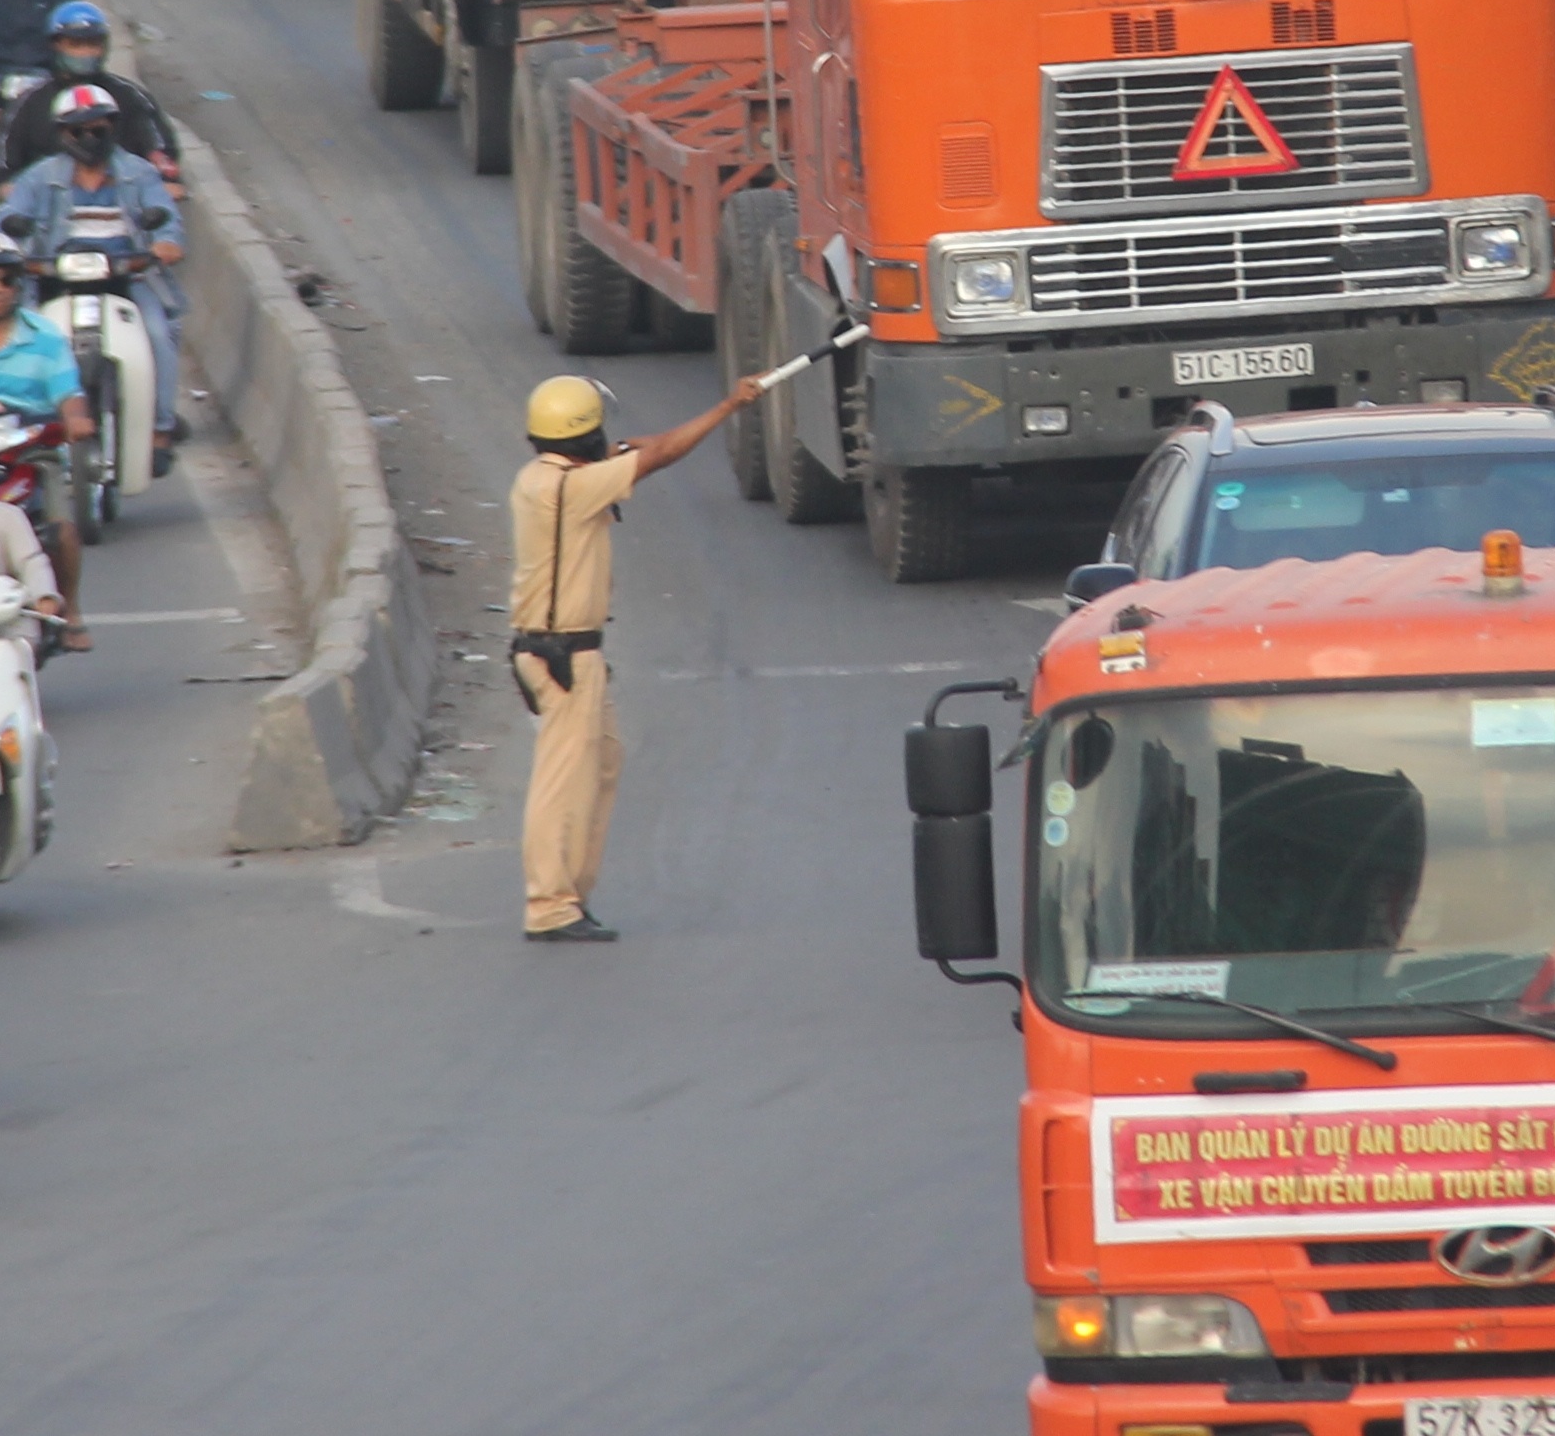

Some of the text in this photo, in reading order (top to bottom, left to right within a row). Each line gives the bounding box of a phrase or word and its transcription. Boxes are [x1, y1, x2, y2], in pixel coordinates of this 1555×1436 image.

[1135, 1131, 1192, 1164] BAN
[1197, 1120, 1271, 1163] QUẢN
[1275, 1120, 1307, 1158] LÝ
[1313, 1121, 1353, 1161] DỰ
[1357, 1119, 1395, 1155] ÁN
[1401, 1116, 1492, 1154] ĐƯỜNG
[1497, 1111, 1549, 1152] SẮT
[1157, 1178, 1194, 1211] XE
[1198, 1172, 1255, 1214] VẬN
[1260, 1162, 1367, 1206] CHUYỂN
[1438, 1160, 1527, 1200] TUYẾN
